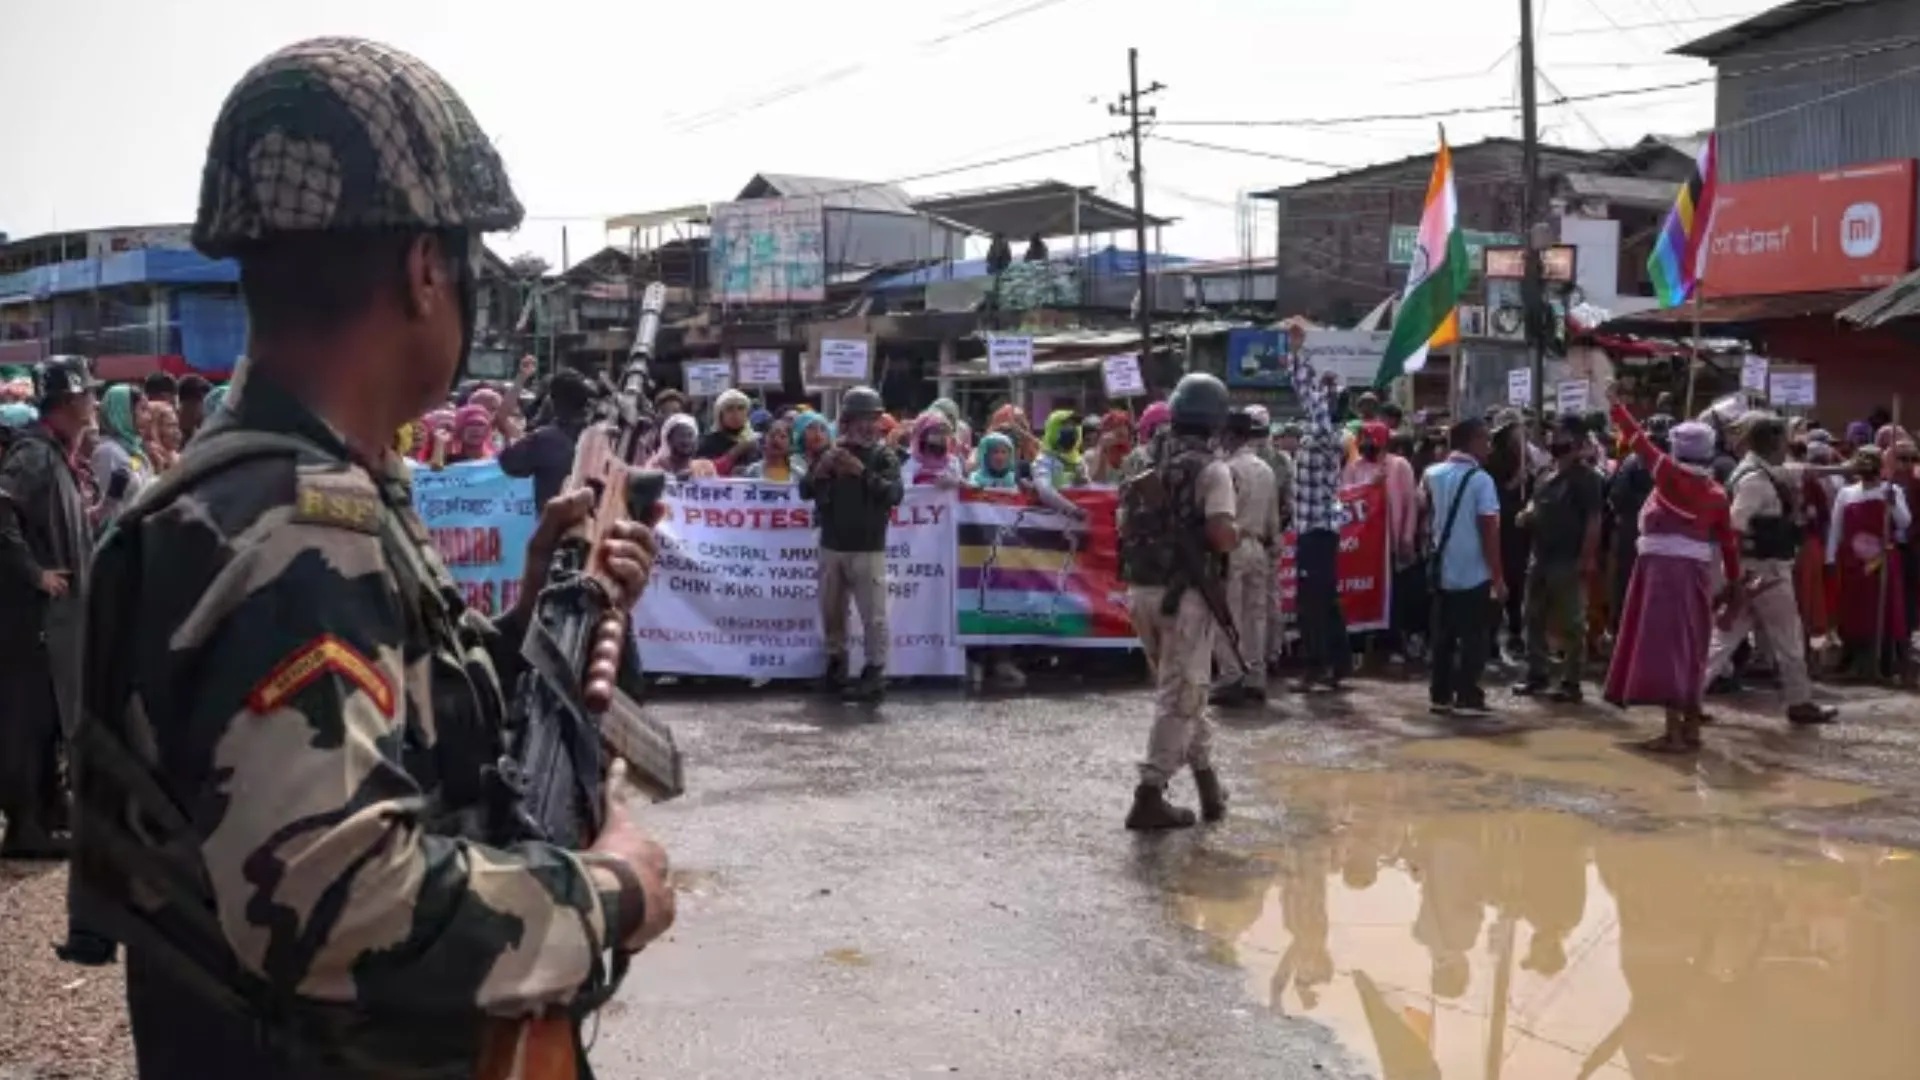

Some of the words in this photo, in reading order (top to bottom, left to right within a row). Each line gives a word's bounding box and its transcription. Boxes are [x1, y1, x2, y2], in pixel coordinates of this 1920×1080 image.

[684, 506, 811, 530] PROTES
[890, 505, 944, 529] LLY
[429, 527, 502, 565] NDRA
[698, 541, 769, 562] CENTRAL
[907, 562, 943, 577] AREA
[669, 576, 712, 594] CHIN
